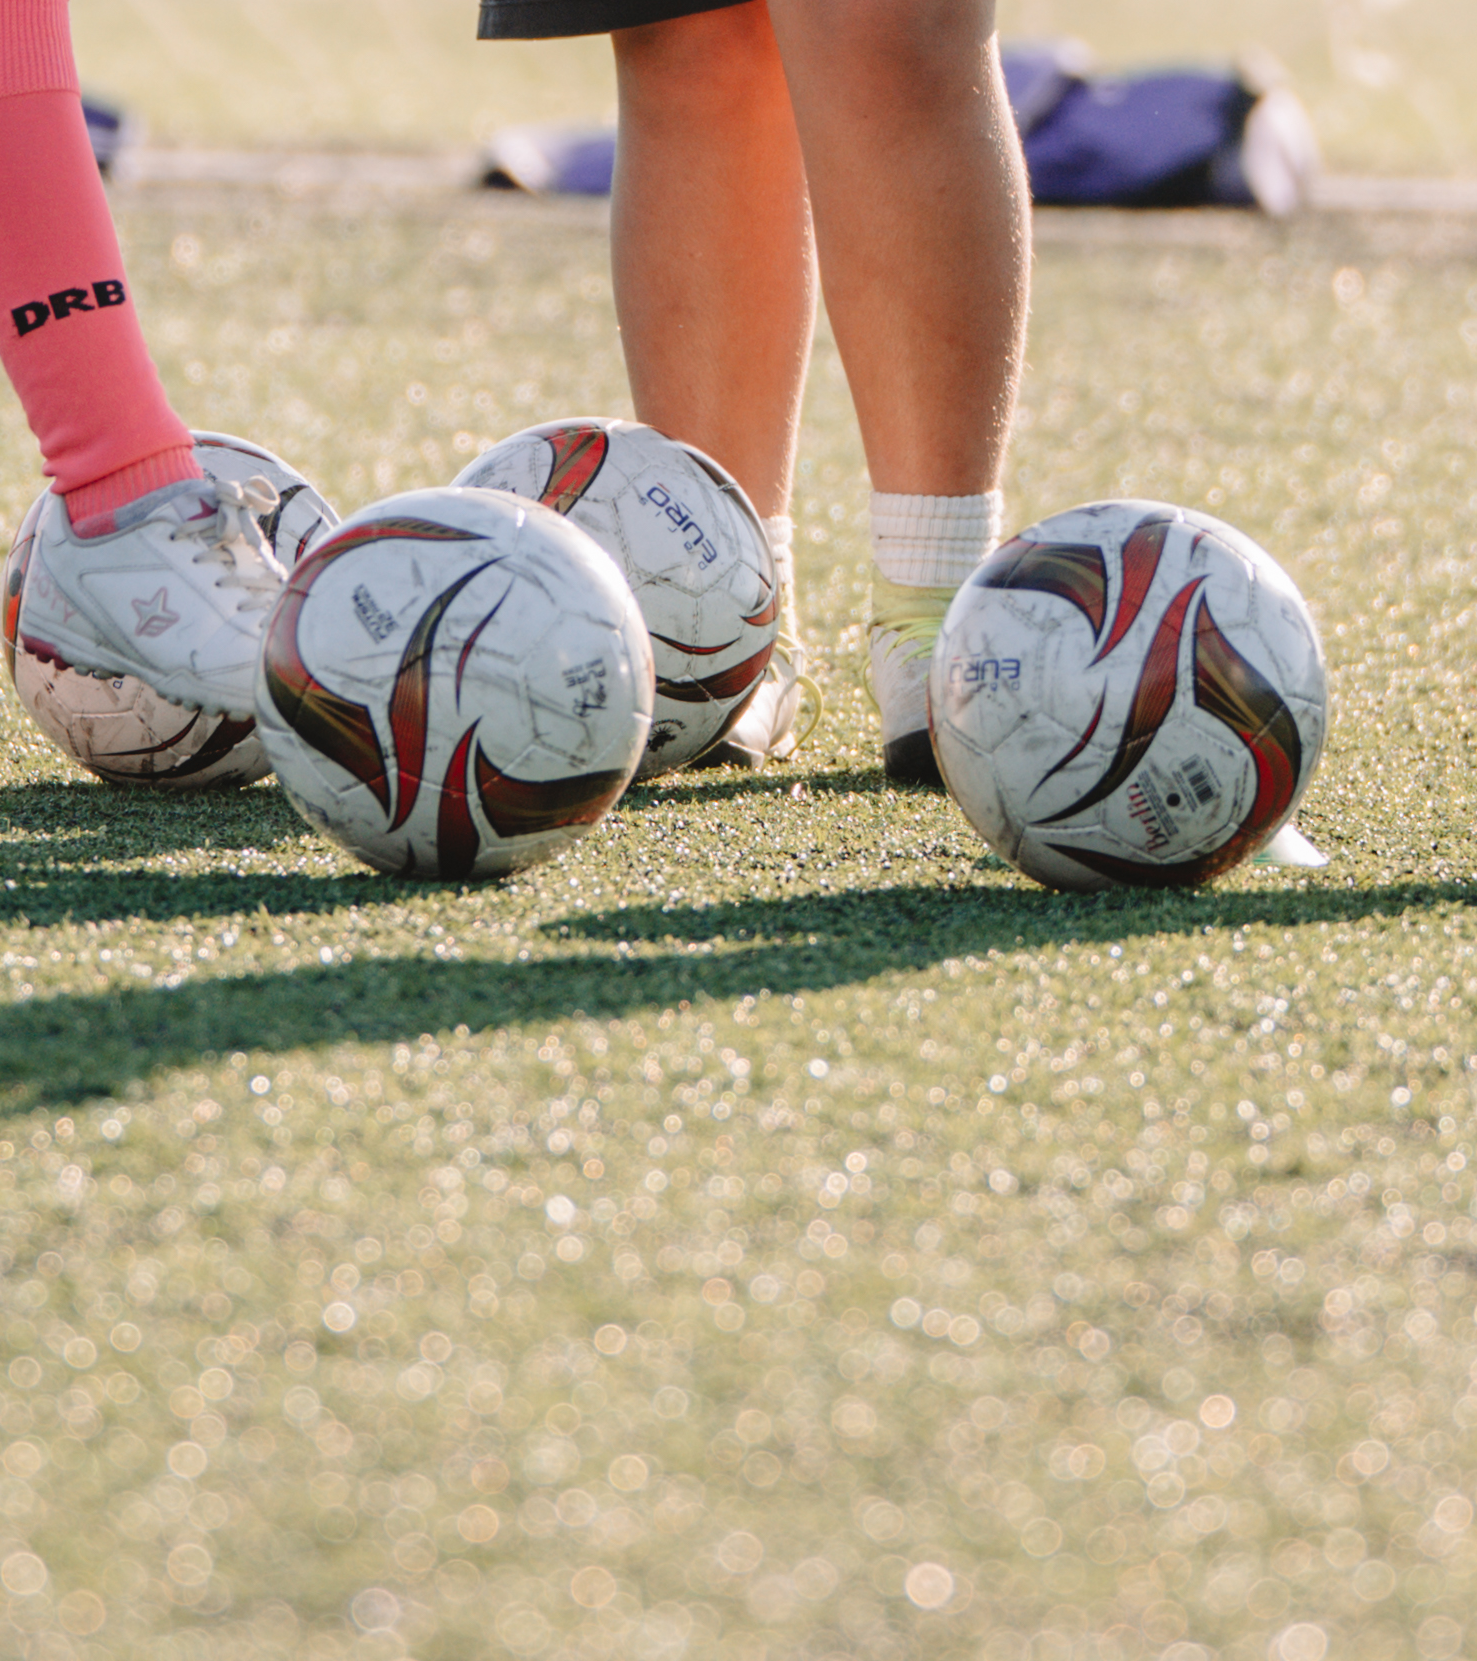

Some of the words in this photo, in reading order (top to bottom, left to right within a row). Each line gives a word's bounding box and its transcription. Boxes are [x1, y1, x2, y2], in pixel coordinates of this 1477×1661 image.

[10, 279, 128, 337] DRB
[647, 487, 717, 564] EURO
[1126, 782, 1170, 852] Berlin
